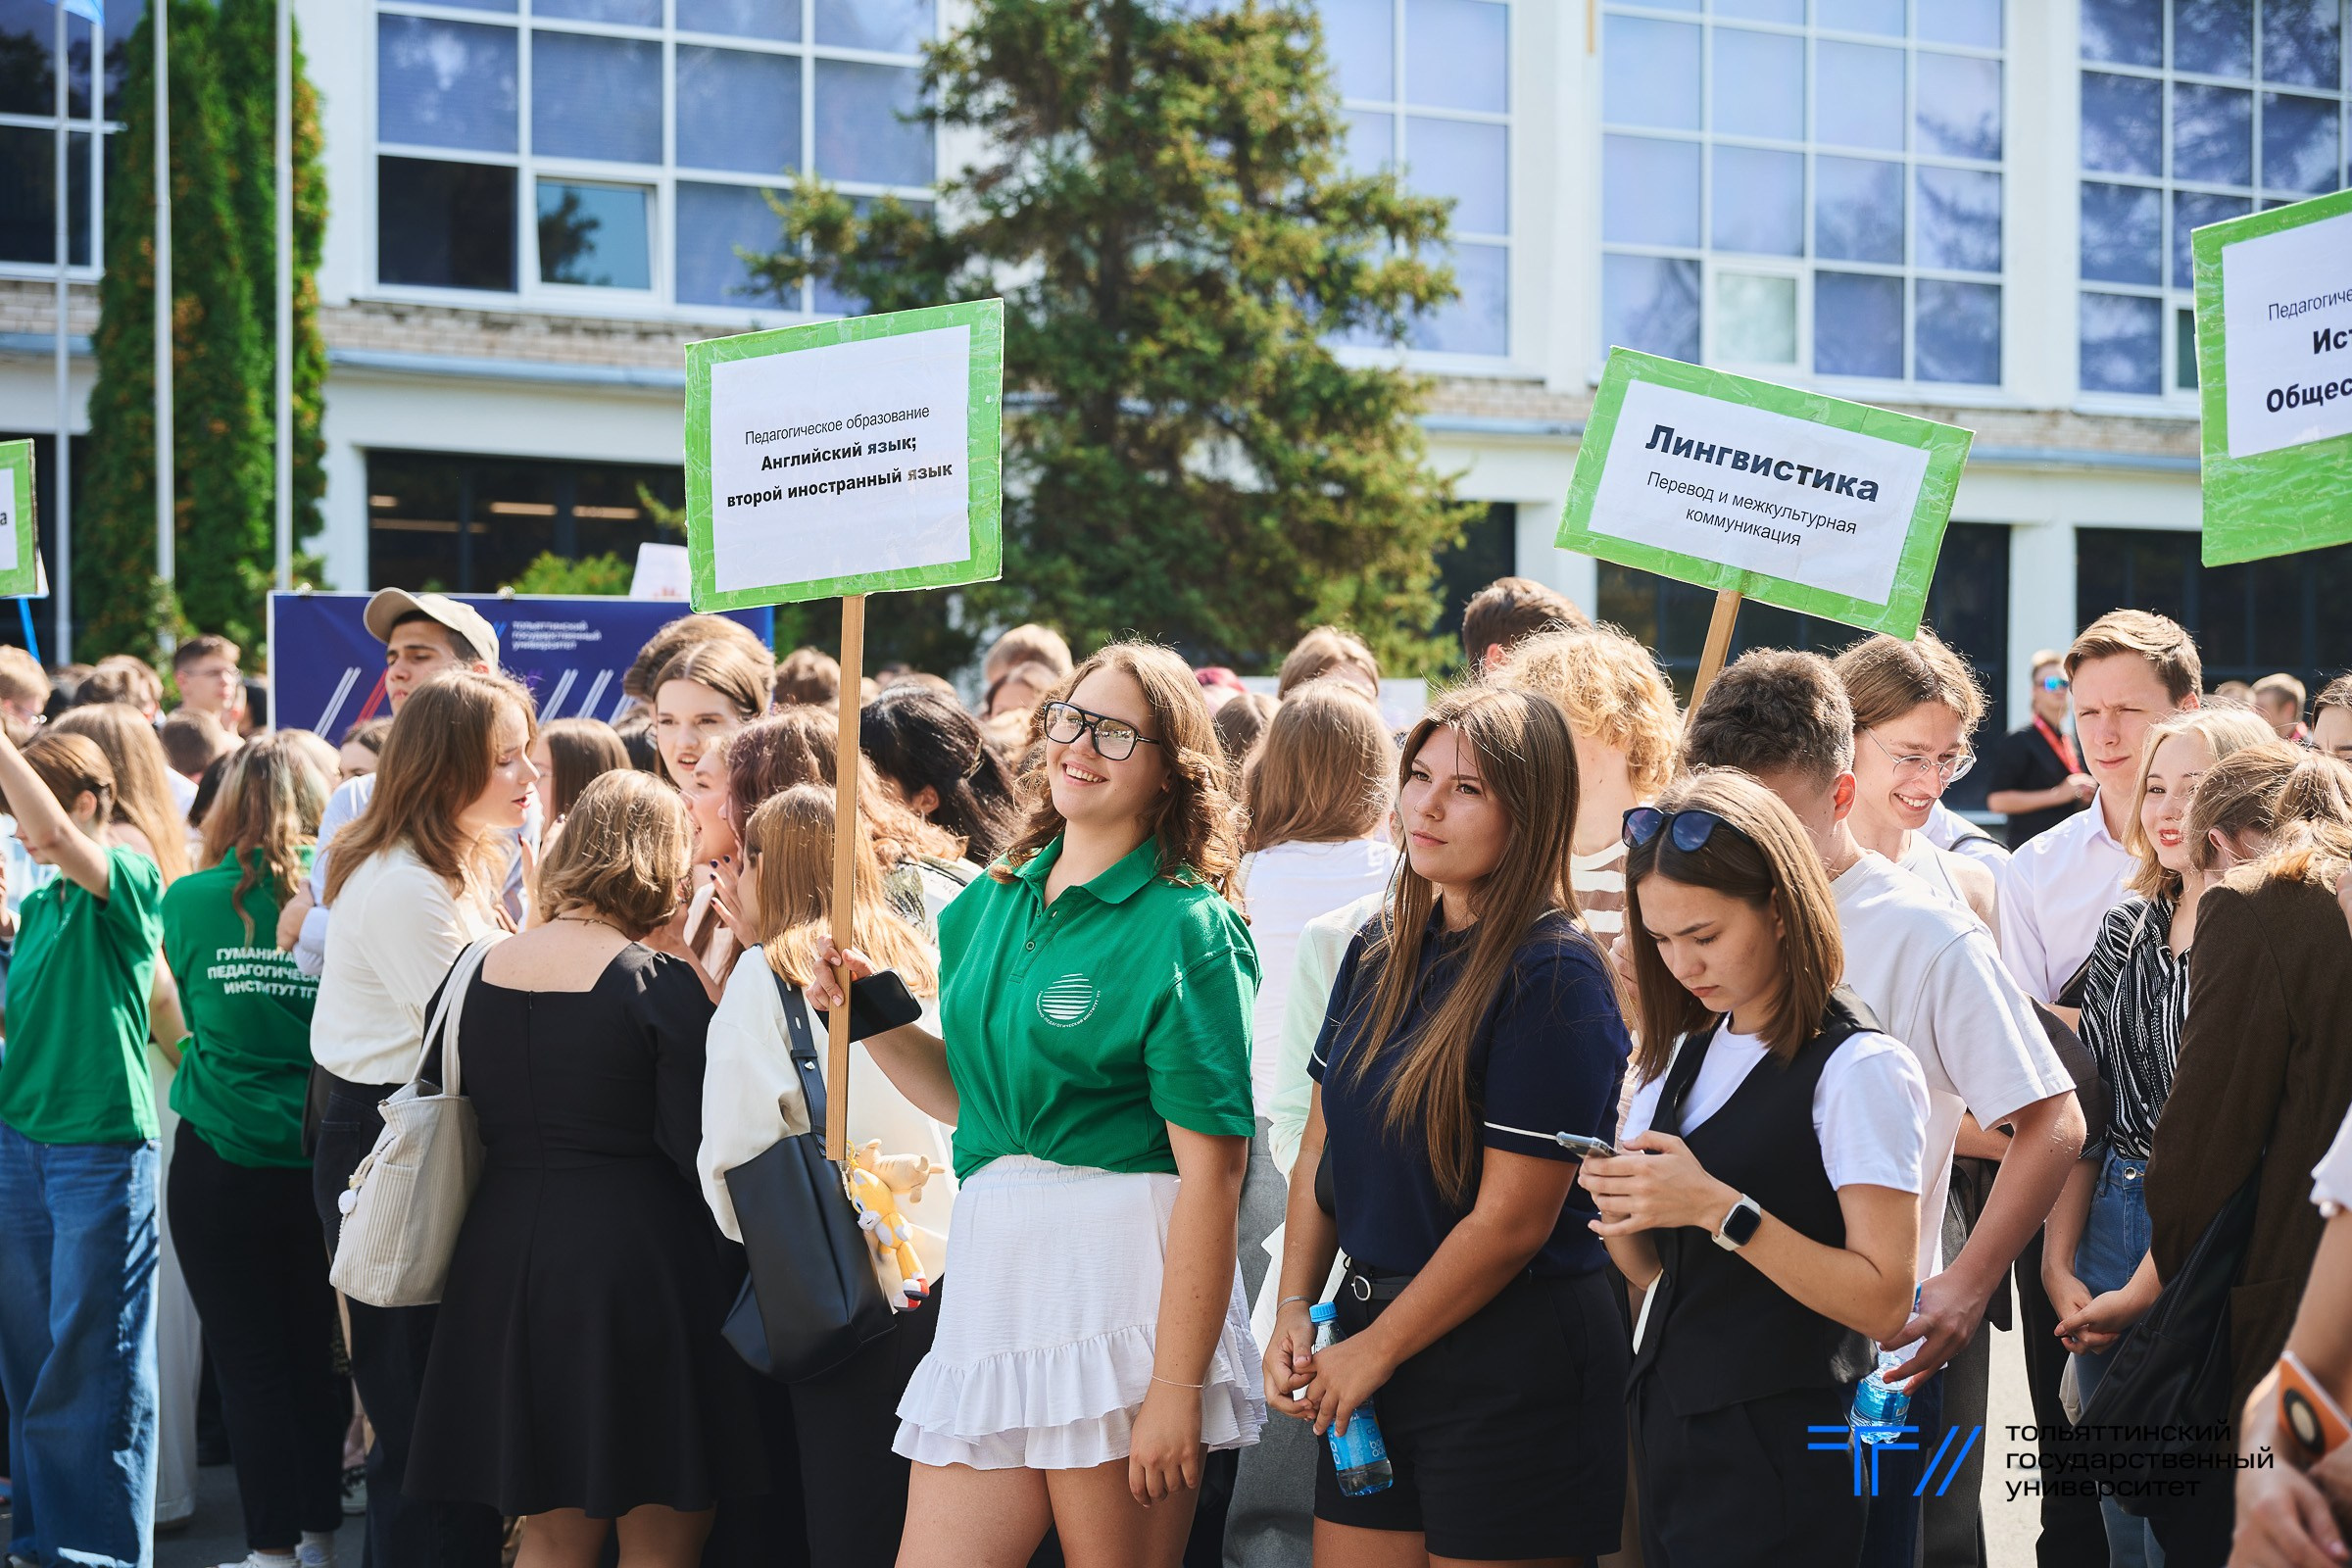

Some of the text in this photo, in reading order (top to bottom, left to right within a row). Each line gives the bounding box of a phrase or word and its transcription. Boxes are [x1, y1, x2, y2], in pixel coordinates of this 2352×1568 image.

[2313, 327, 2352, 355] Ис
[745, 406, 930, 446] Педагогическое образование
[760, 436, 916, 471] Английский язык;
[1644, 423, 1880, 503] Лингвистика
[727, 463, 954, 508] второй иностранный язык
[1646, 470, 1857, 535] Перевод и межкультурная
[1686, 508, 1801, 547] коммуникация
[223, 979, 299, 997] ИНСТИТУТ
[299, 985, 318, 1000] ТГ
